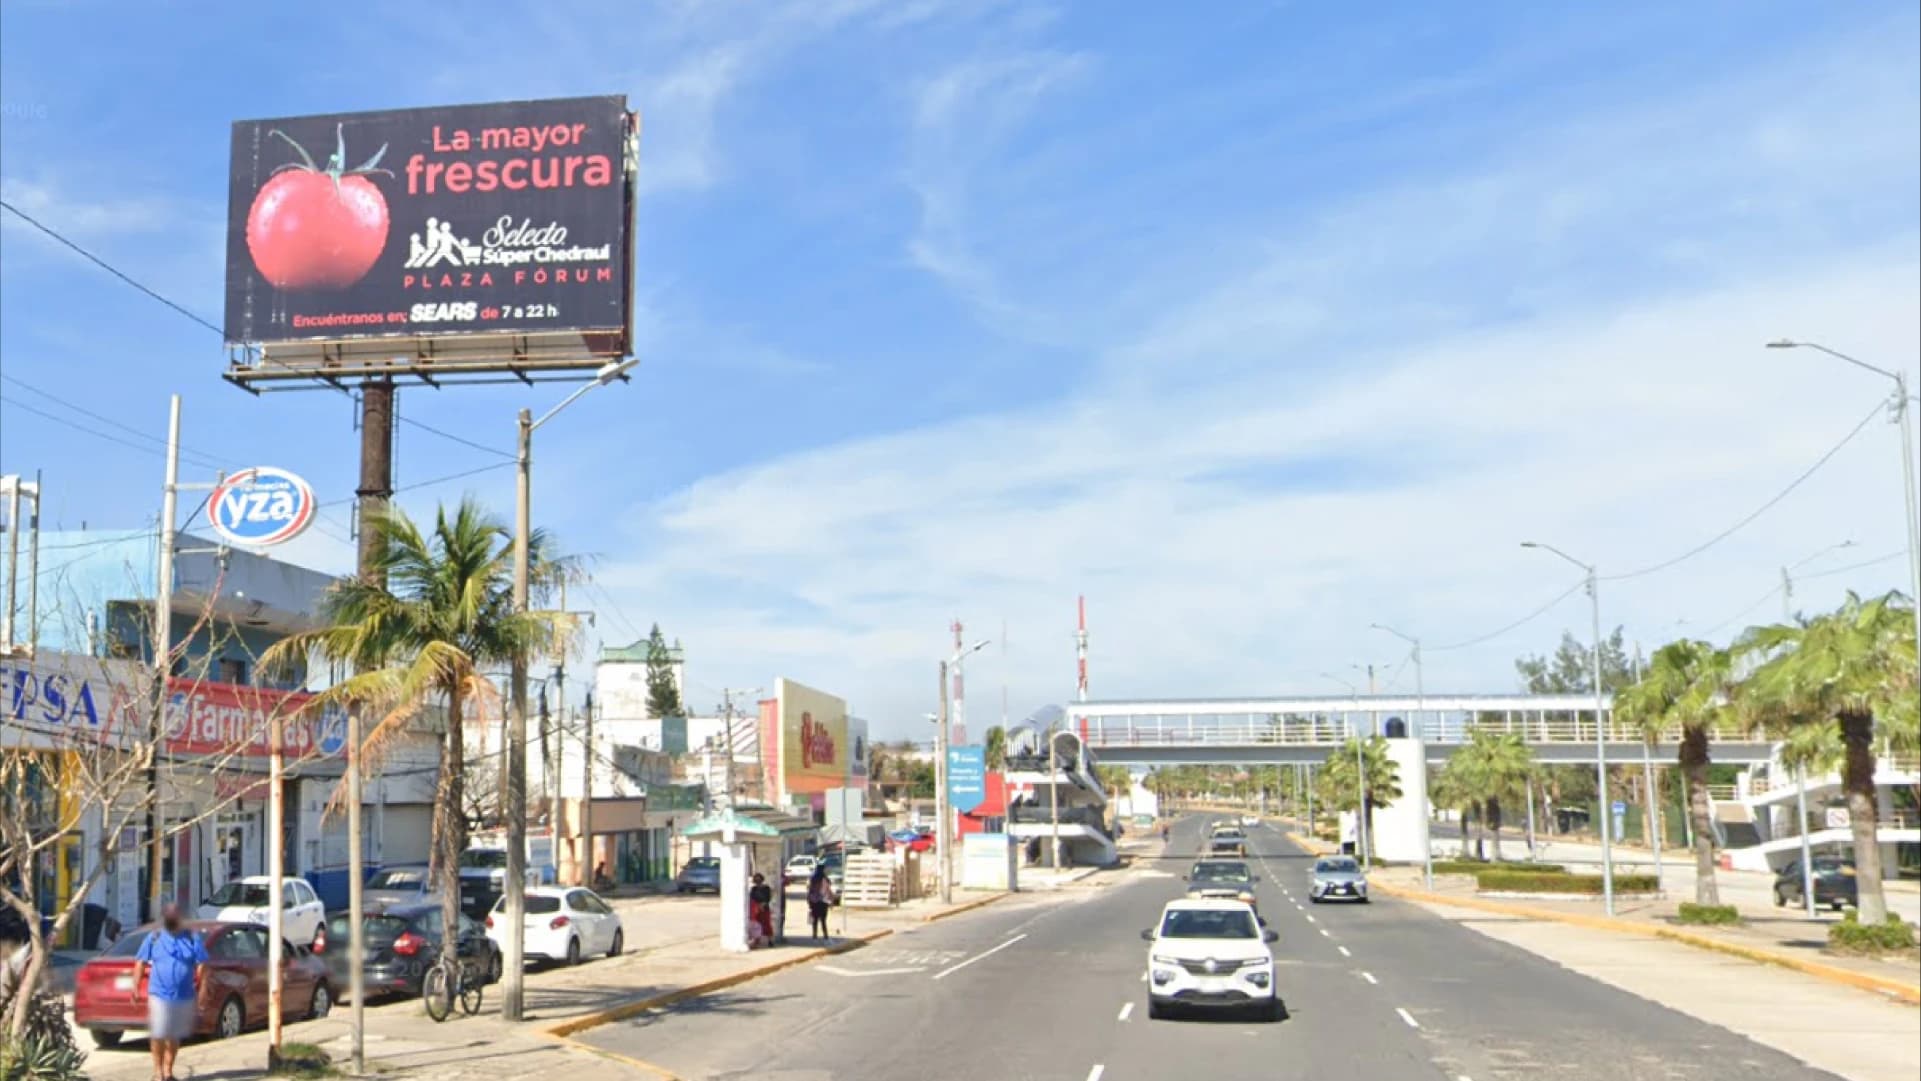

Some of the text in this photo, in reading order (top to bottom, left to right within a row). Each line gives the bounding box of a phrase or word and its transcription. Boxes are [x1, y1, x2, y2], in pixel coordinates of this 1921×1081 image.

[432, 123, 585, 152] La mayor
[405, 154, 611, 194] frescura
[482, 215, 568, 248] Selecto
[483, 243, 611, 267] Súper Chedraui
[403, 267, 612, 289] PLAZA FÓRUM
[293, 312, 384, 328] Encuéntranos
[410, 302, 478, 323] SEARS
[480, 307, 499, 319] de
[501, 305, 513, 318] 7
[513, 307, 524, 318] a
[525, 304, 545, 318] 22
[225, 490, 295, 529] yza
[190, 694, 310, 748] Farmaas
